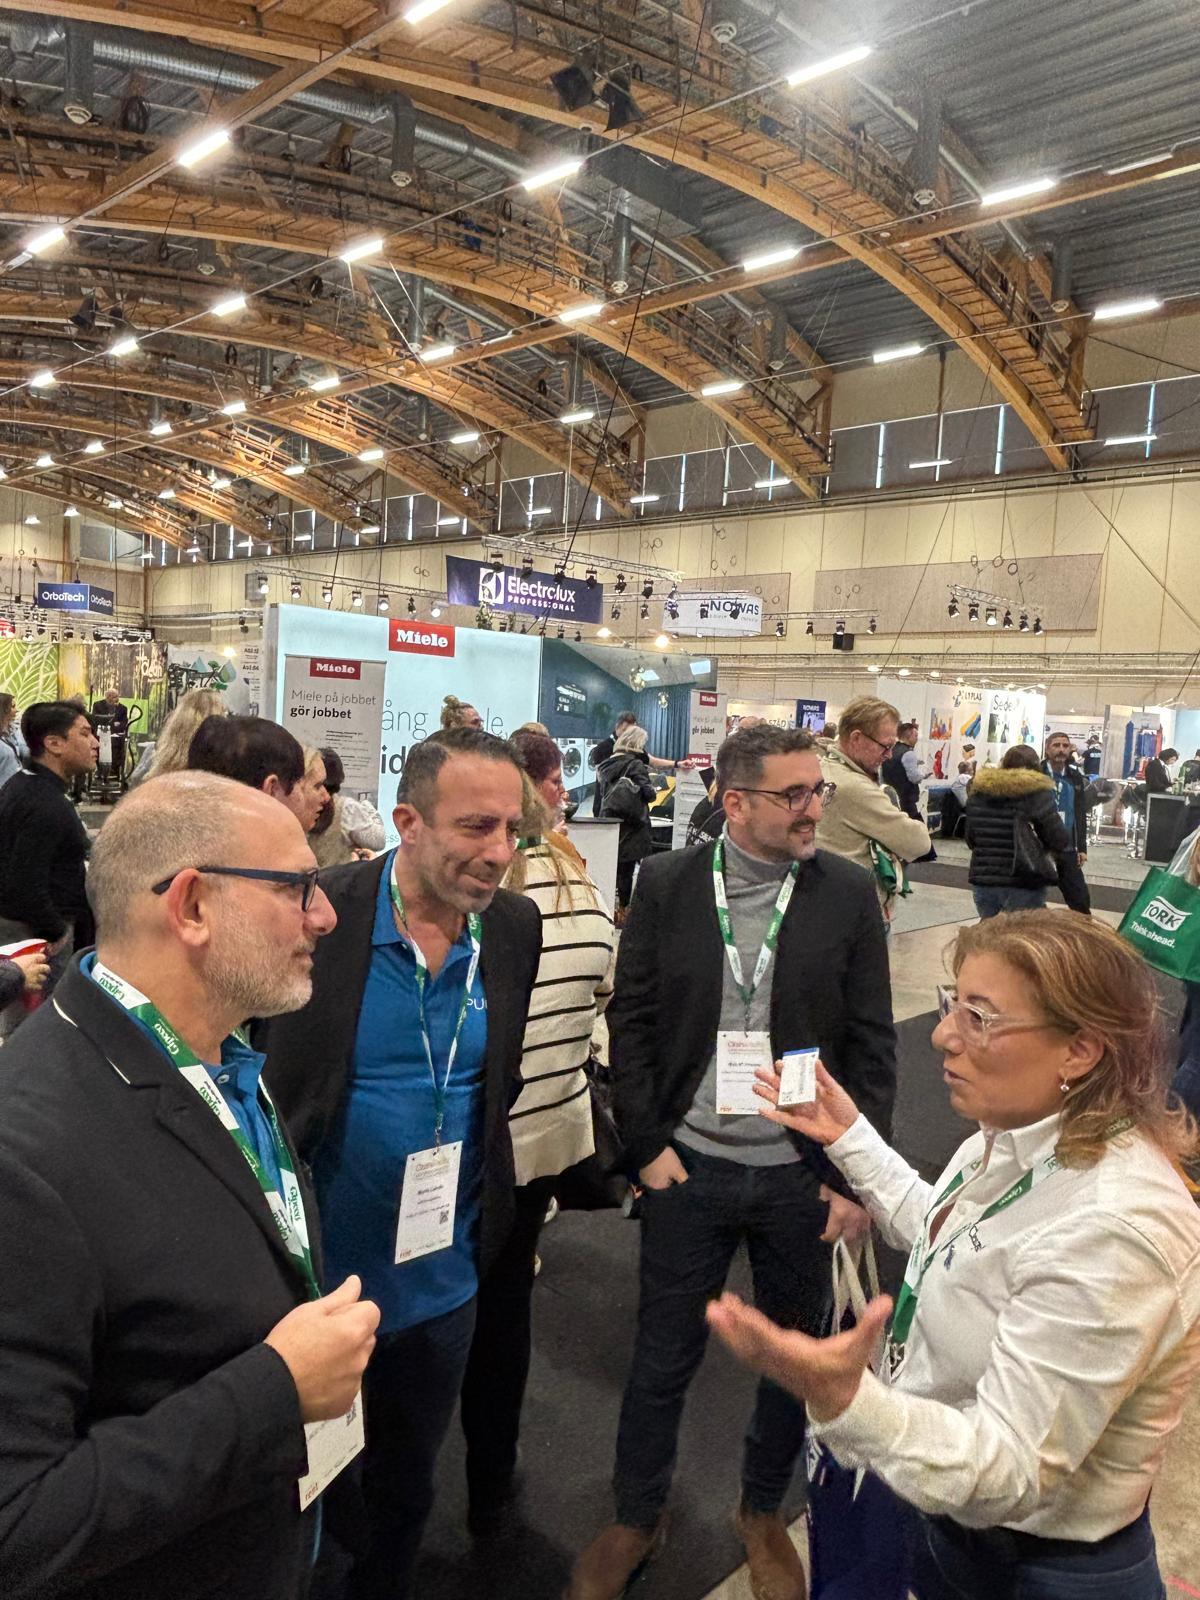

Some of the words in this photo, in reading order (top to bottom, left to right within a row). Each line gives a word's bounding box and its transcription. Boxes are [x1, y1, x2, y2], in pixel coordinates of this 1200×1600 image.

[41, 591, 85, 602] OrboTech
[507, 575, 576, 604] Electrolux
[90, 593, 113, 608] OrboTech
[507, 595, 576, 613] PROFESSIONAL
[396, 630, 449, 649] Miele
[315, 662, 356, 675] Miele
[291, 689, 323, 703] Miele
[324, 690, 338, 704] på
[341, 691, 377, 706] jobbet
[289, 705, 311, 719] gör
[312, 707, 352, 720] jobbet
[381, 699, 429, 741] ång
[485, 707, 509, 740] le,
[381, 746, 407, 775] id
[1148, 903, 1181, 928] TORK
[1130, 920, 1148, 938] Think
[1146, 931, 1175, 949] ahead.
[153, 1022, 180, 1056] Gipeco
